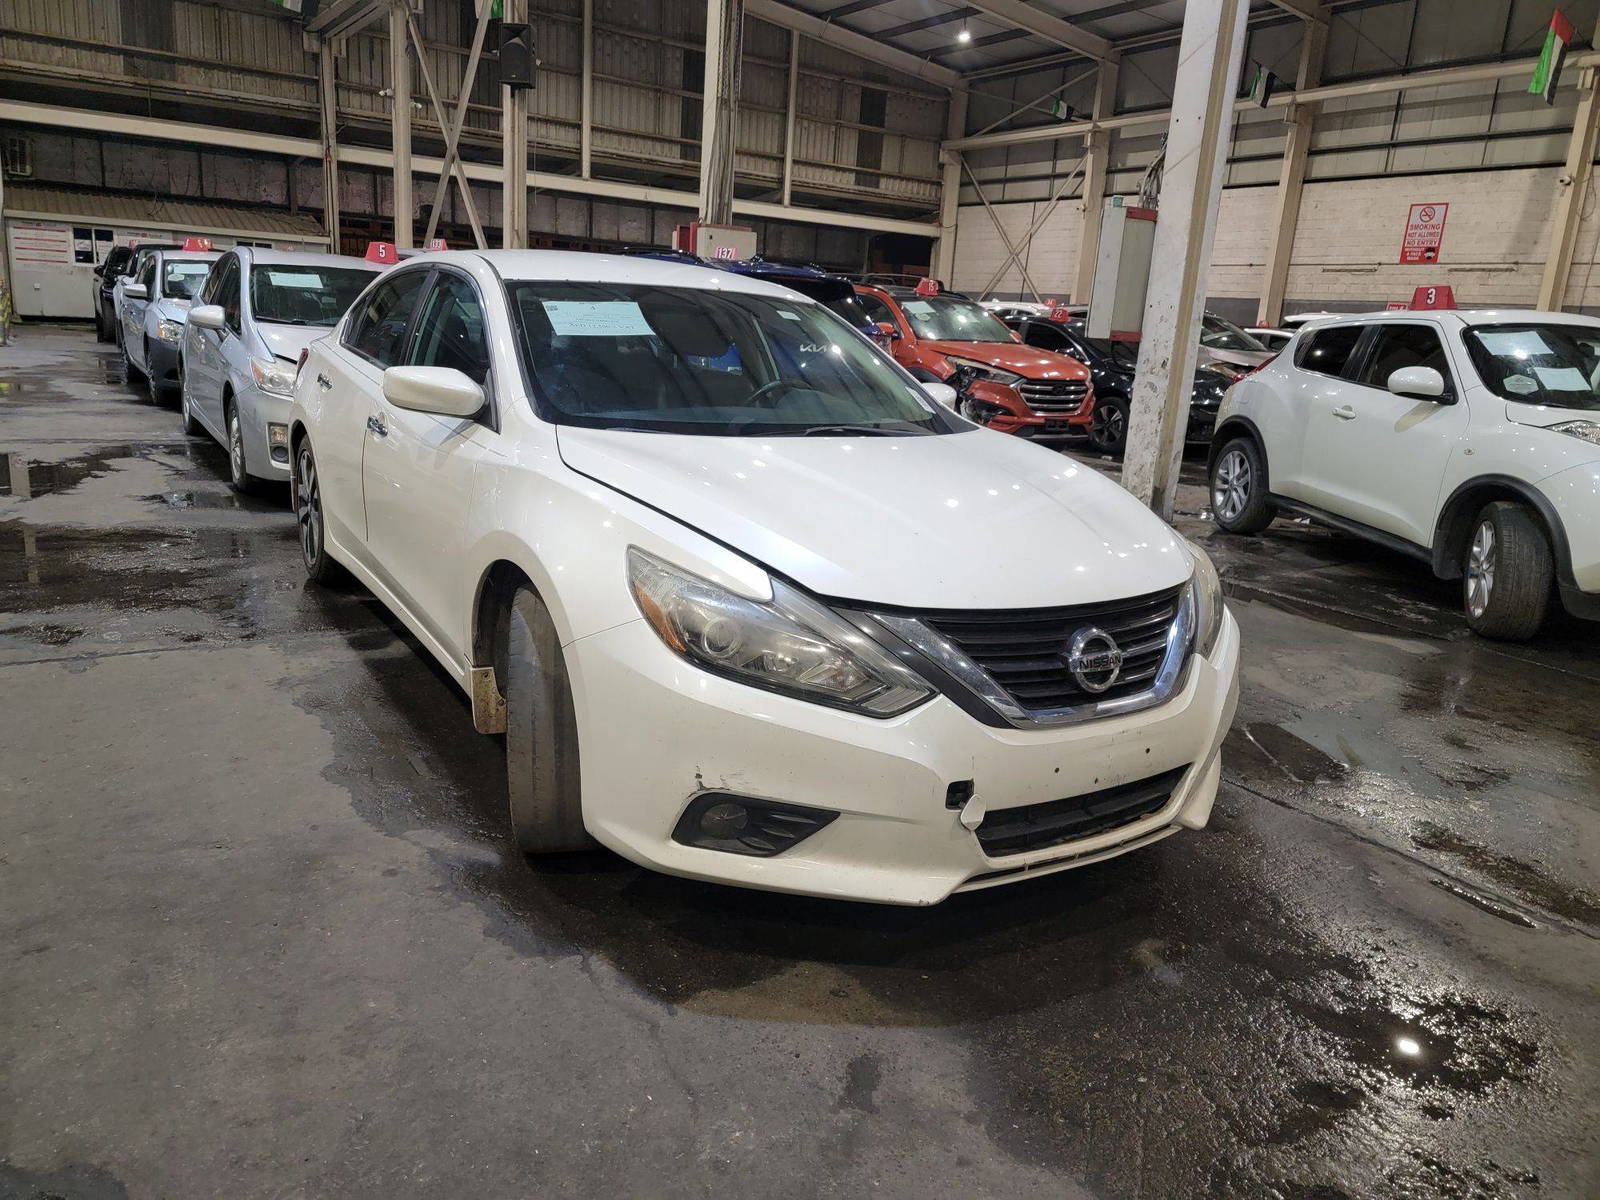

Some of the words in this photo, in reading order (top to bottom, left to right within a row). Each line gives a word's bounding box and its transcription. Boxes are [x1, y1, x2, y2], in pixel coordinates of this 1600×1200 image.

[379, 245, 386, 258] 5
[719, 248, 732, 259] 137
[1426, 288, 1436, 304] 3
[1079, 654, 1121, 670] NISSAN
